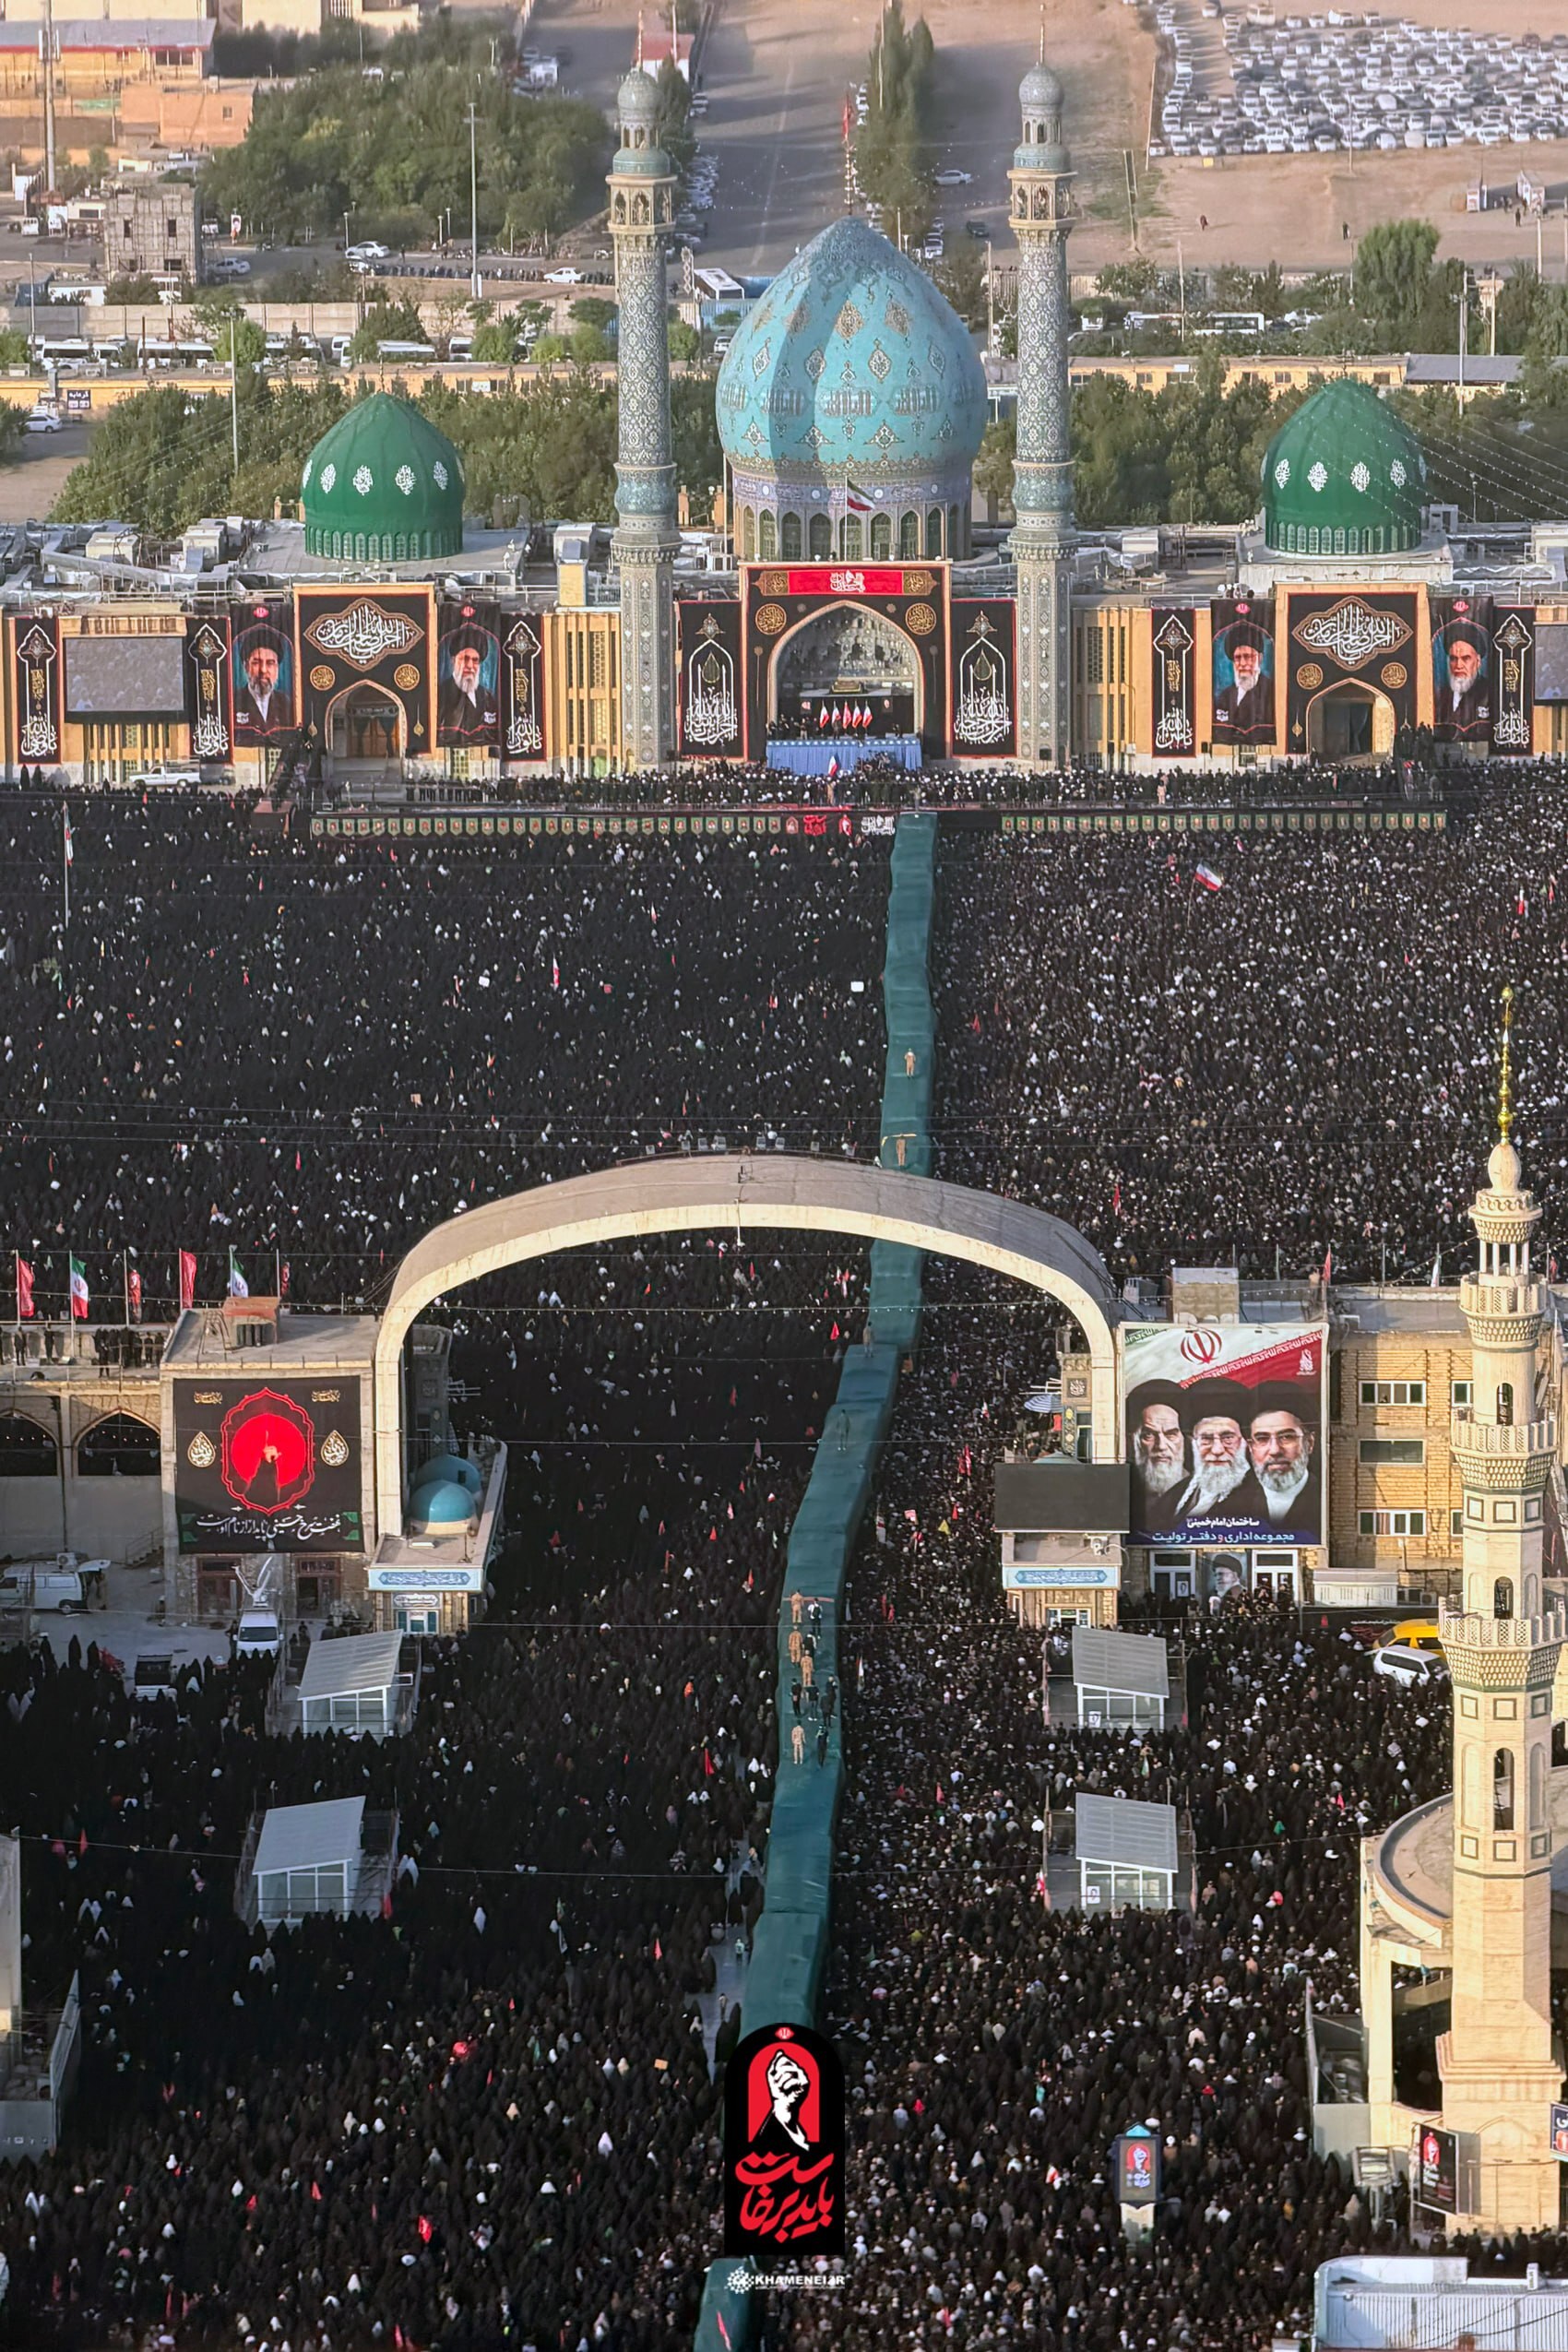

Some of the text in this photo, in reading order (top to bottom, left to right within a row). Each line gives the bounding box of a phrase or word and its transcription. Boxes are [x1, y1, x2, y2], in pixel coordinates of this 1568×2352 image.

[1210, 1517, 1227, 1528] امام
[1227, 1517, 1260, 1528] ساختمان
[1152, 1530, 1295, 1544] مجموعه اداری و دفتر تولیت
